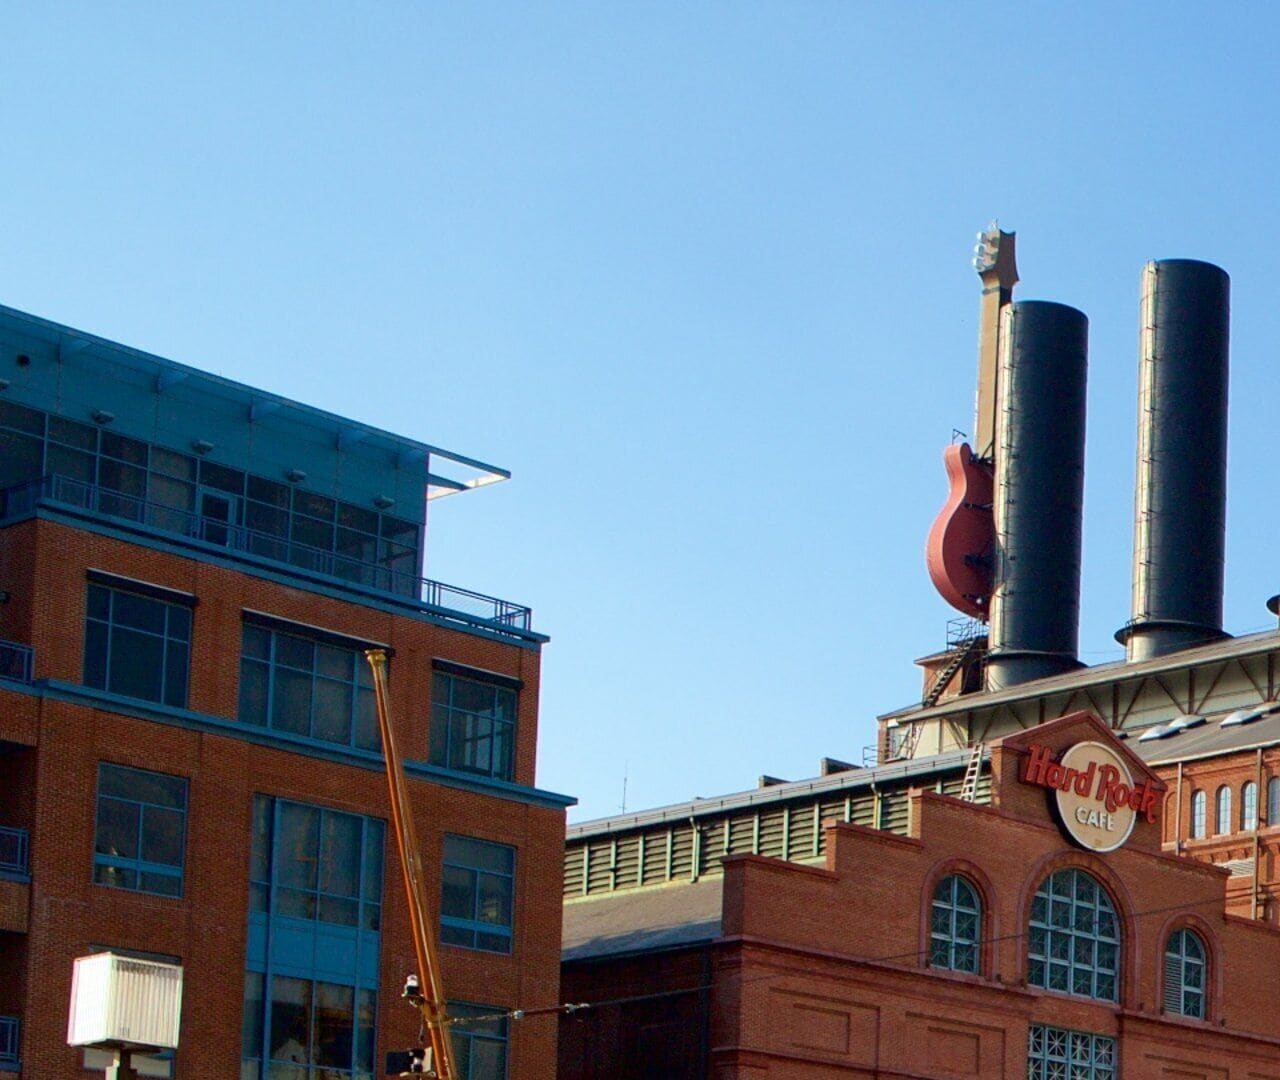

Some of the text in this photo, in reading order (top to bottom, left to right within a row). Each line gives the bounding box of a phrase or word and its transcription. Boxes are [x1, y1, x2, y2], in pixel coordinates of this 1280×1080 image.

[1026, 744, 1157, 824] Hard Rock
[1075, 806, 1115, 832] CAFE
